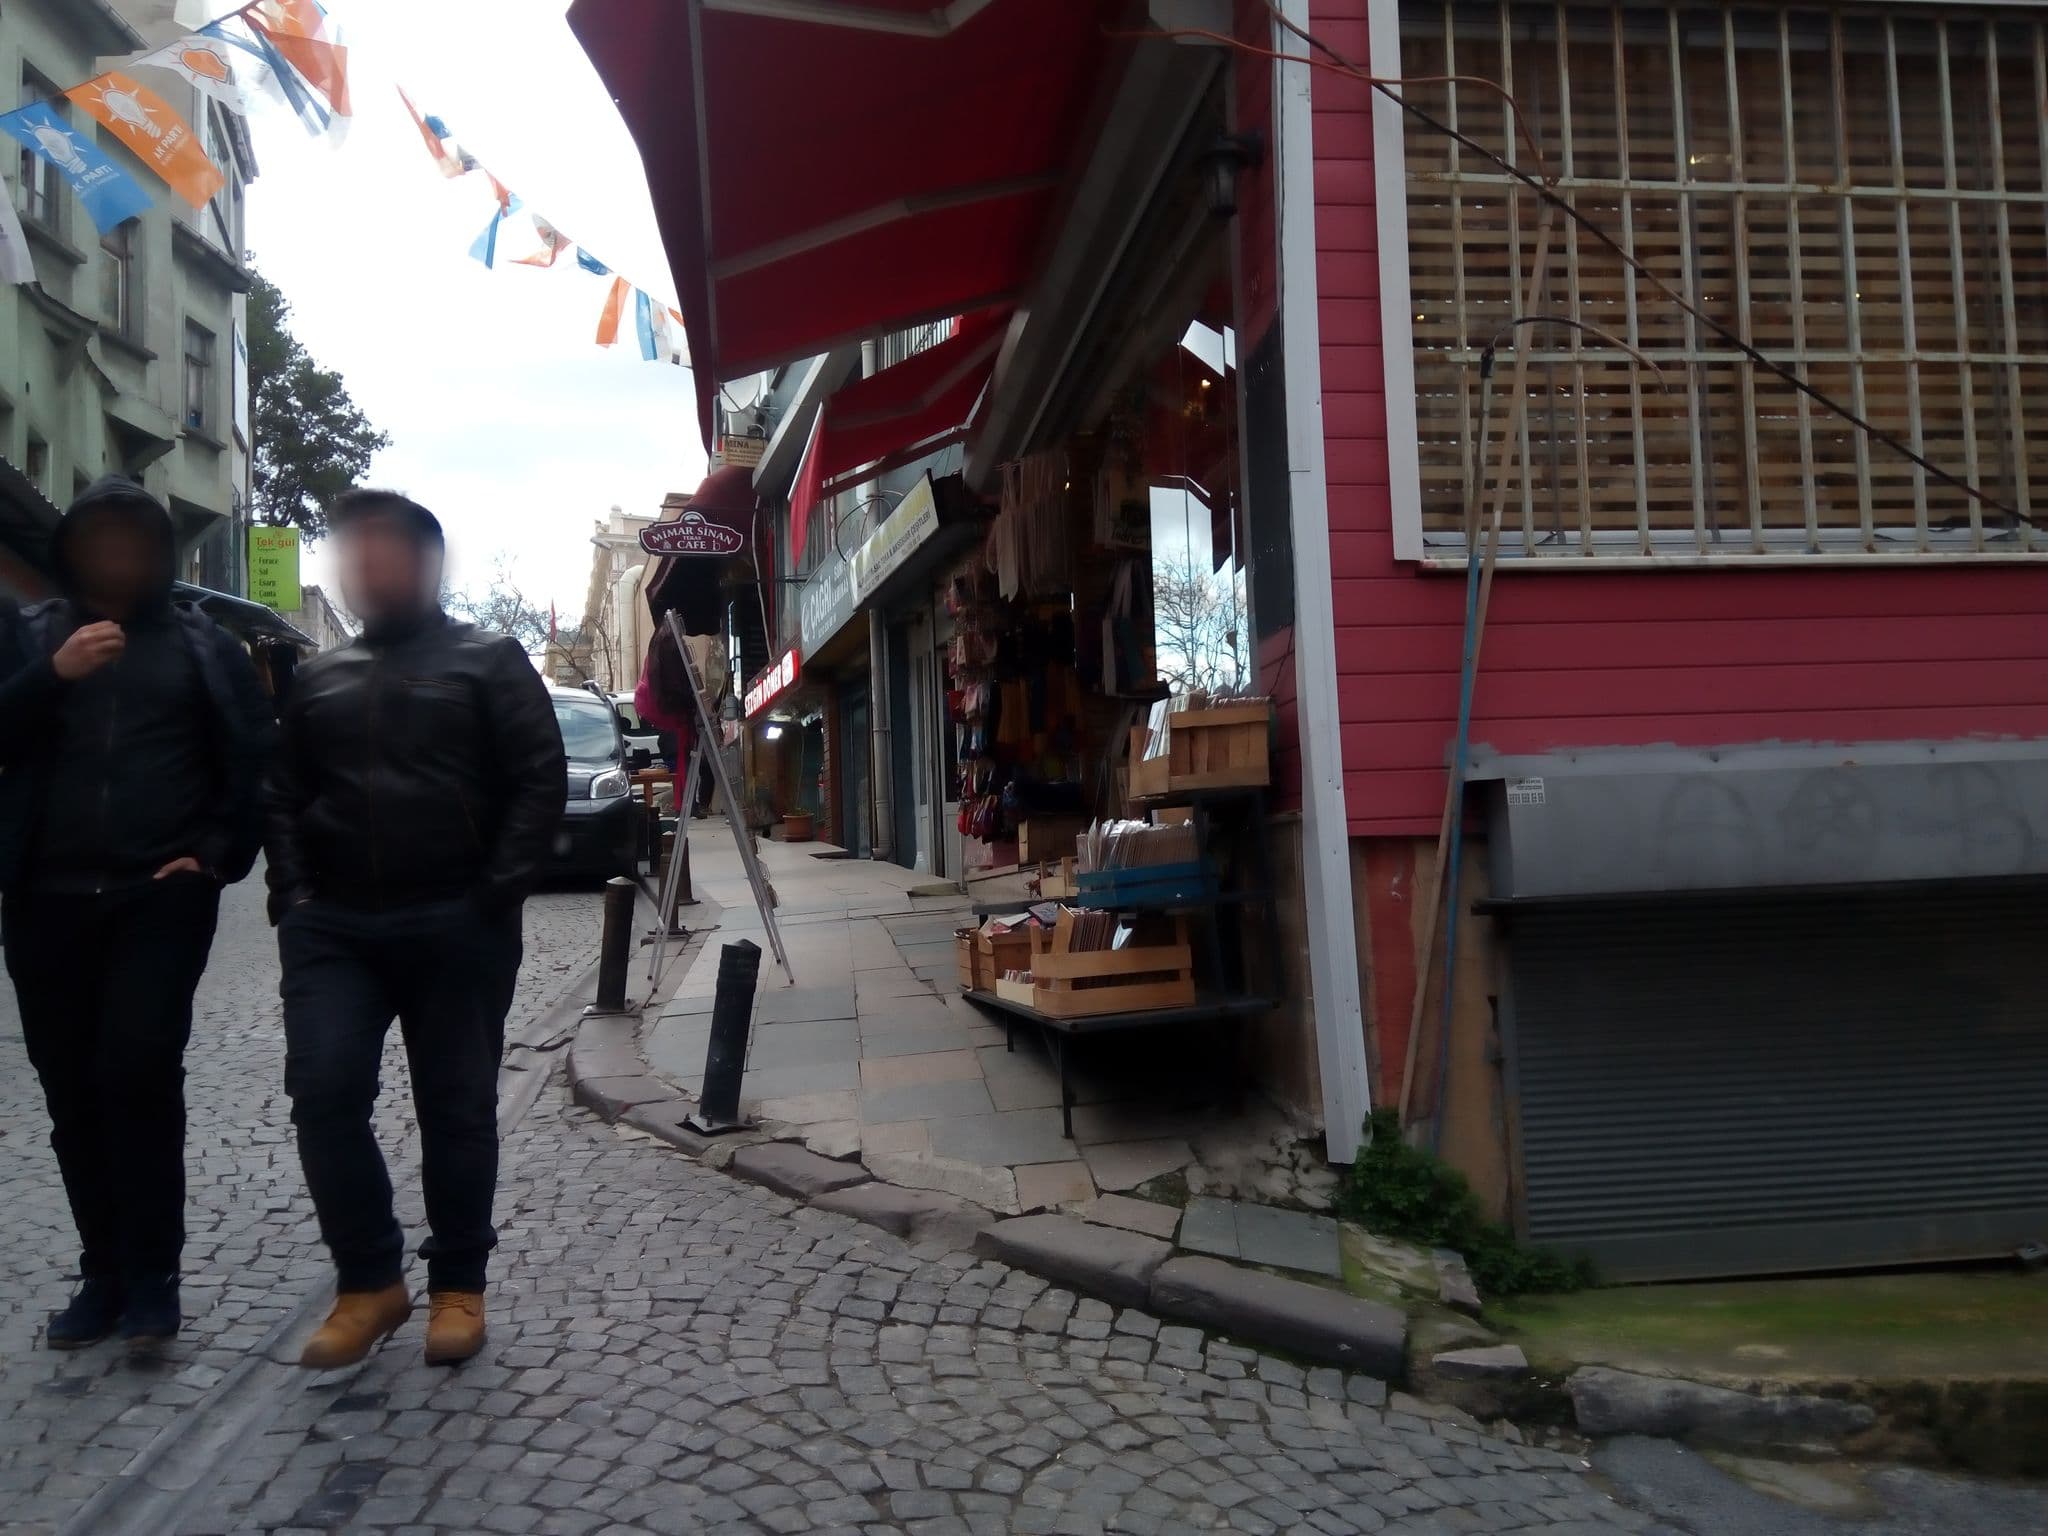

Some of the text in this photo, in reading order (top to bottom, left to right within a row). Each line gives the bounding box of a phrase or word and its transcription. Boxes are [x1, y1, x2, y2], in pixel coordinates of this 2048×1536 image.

[651, 525, 734, 546] MİMAR SİNAN
[256, 537, 295, 549] Tek gül
[677, 540, 707, 550] CAFE
